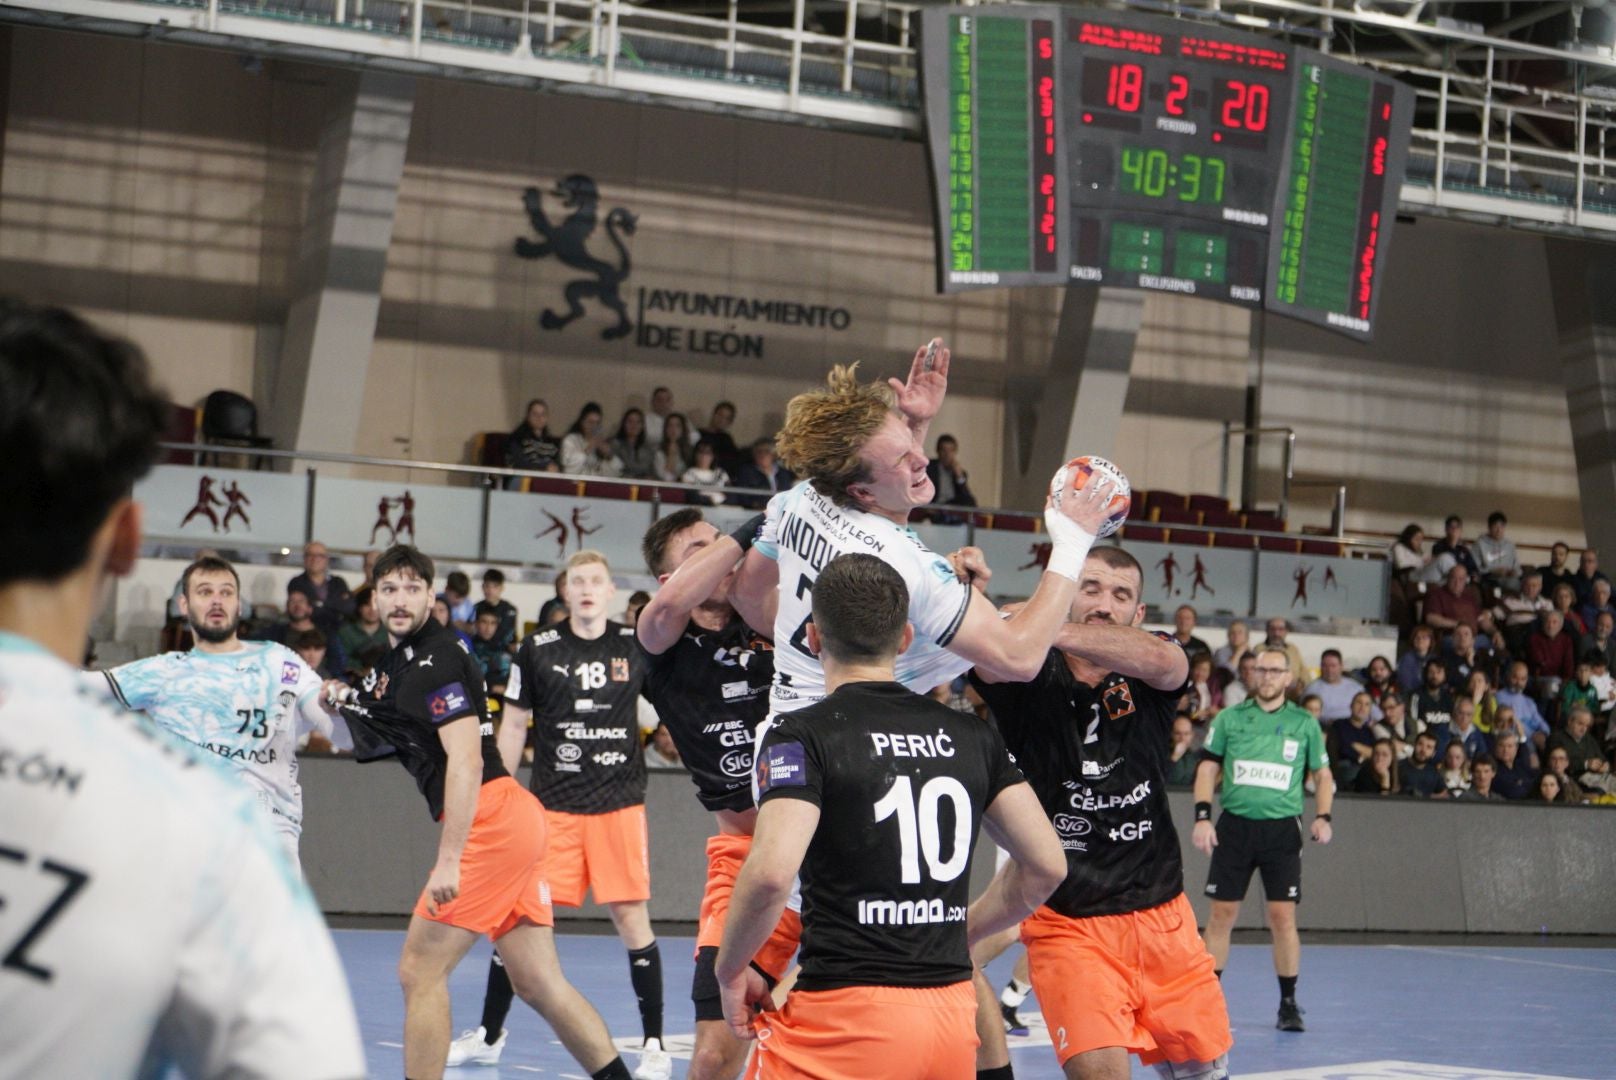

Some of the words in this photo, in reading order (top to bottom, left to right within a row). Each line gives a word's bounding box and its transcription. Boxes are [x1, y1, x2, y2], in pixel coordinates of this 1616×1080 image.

[960, 15, 971, 34] E
[1039, 38, 1053, 59] 5
[1311, 66, 1320, 83] E
[1039, 76, 1054, 97] 2
[1107, 63, 1143, 112] 18
[1165, 74, 1189, 115] 2
[1222, 80, 1270, 131] 20
[1382, 103, 1391, 121] 1
[1045, 118, 1054, 136] 1
[1046, 137, 1054, 155] 1
[1373, 136, 1387, 156] 2
[1040, 173, 1055, 195] 2
[1121, 148, 1226, 203] 40:37
[1047, 195, 1055, 213] 1
[1040, 213, 1055, 234] 2
[1222, 207, 1268, 227] MONDO
[1046, 234, 1055, 253] 1
[1138, 273, 1196, 294] EXCLUSIONES
[648, 288, 851, 331] AYUNTAMIENTO
[645, 323, 682, 351] DE
[687, 323, 765, 359] LEÓN
[803, 487, 842, 526] CASTILLA
[841, 518, 851, 531] Y
[848, 525, 885, 553] LEÓN
[574, 660, 608, 691] 18
[236, 708, 269, 739] 73
[564, 727, 628, 740] CELLPACK
[724, 719, 745, 731] BBC
[1083, 702, 1101, 745] 2
[719, 730, 756, 748] CEL
[870, 727, 956, 758] PERIĆ
[726, 753, 752, 773] SIG
[771, 764, 799, 774] EUROPEAN
[1249, 766, 1288, 783] DEKRA
[873, 775, 973, 885] 10
[1056, 817, 1086, 832] SIG
[1056, 1026, 1068, 1050] 2
